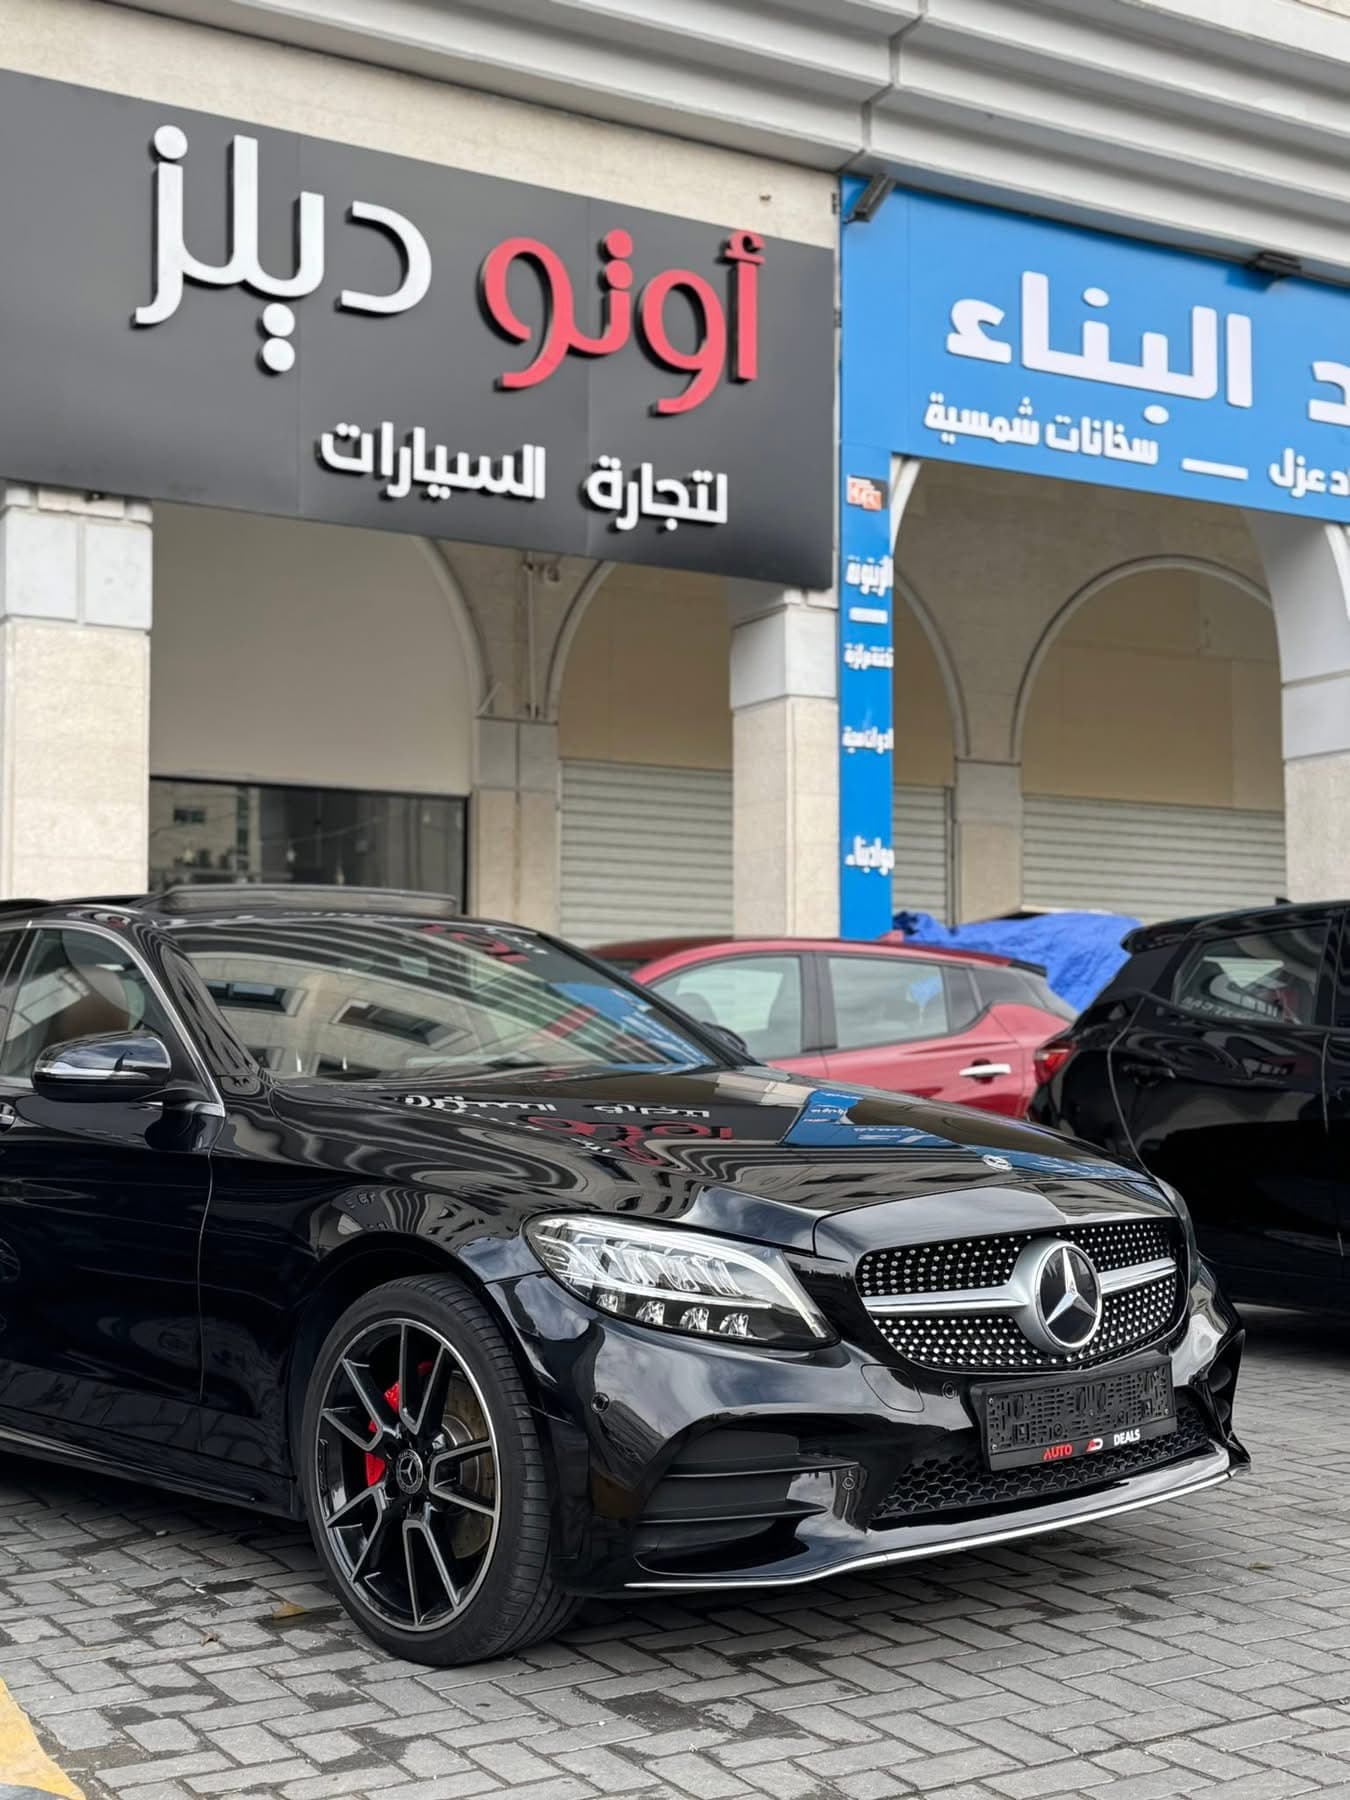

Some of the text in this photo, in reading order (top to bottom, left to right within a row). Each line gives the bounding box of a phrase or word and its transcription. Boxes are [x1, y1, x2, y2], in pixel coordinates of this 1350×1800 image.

[134, 124, 765, 413] أوتو ديلز
[946, 270, 1253, 424] البناء
[924, 392, 1040, 446] شمسية
[1045, 414, 1159, 465] سخانات
[320, 421, 728, 531] لتجارة السيارات
[1042, 1443, 1073, 1462] AUTO
[1113, 1428, 1141, 1447] DEALS
